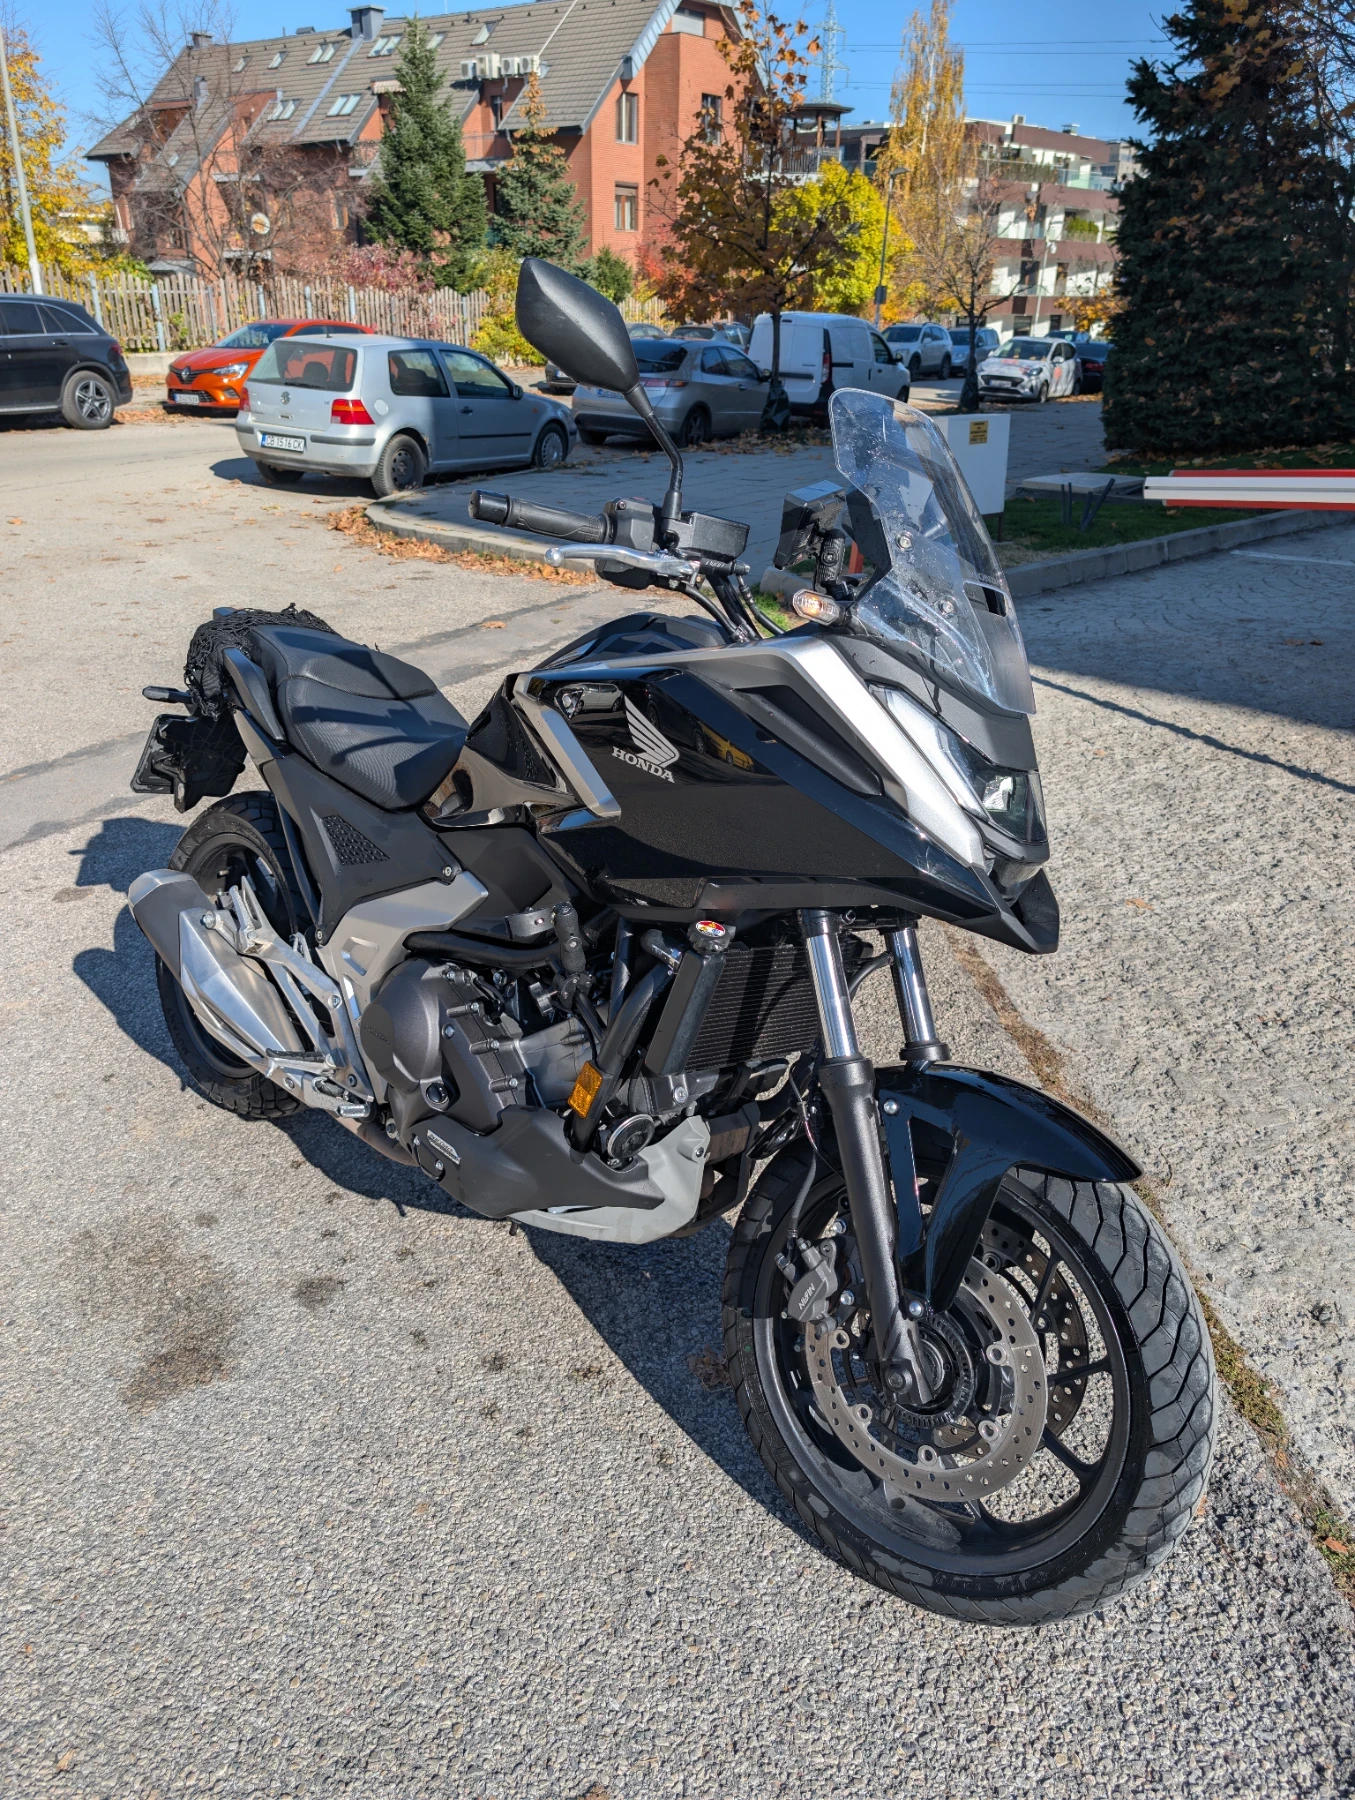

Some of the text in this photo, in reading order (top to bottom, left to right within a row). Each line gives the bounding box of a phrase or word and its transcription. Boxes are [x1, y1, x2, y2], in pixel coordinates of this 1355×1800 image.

[276, 437, 293, 449] 1516
[293, 439, 304, 450] CK
[611, 746, 675, 783] HONDA
